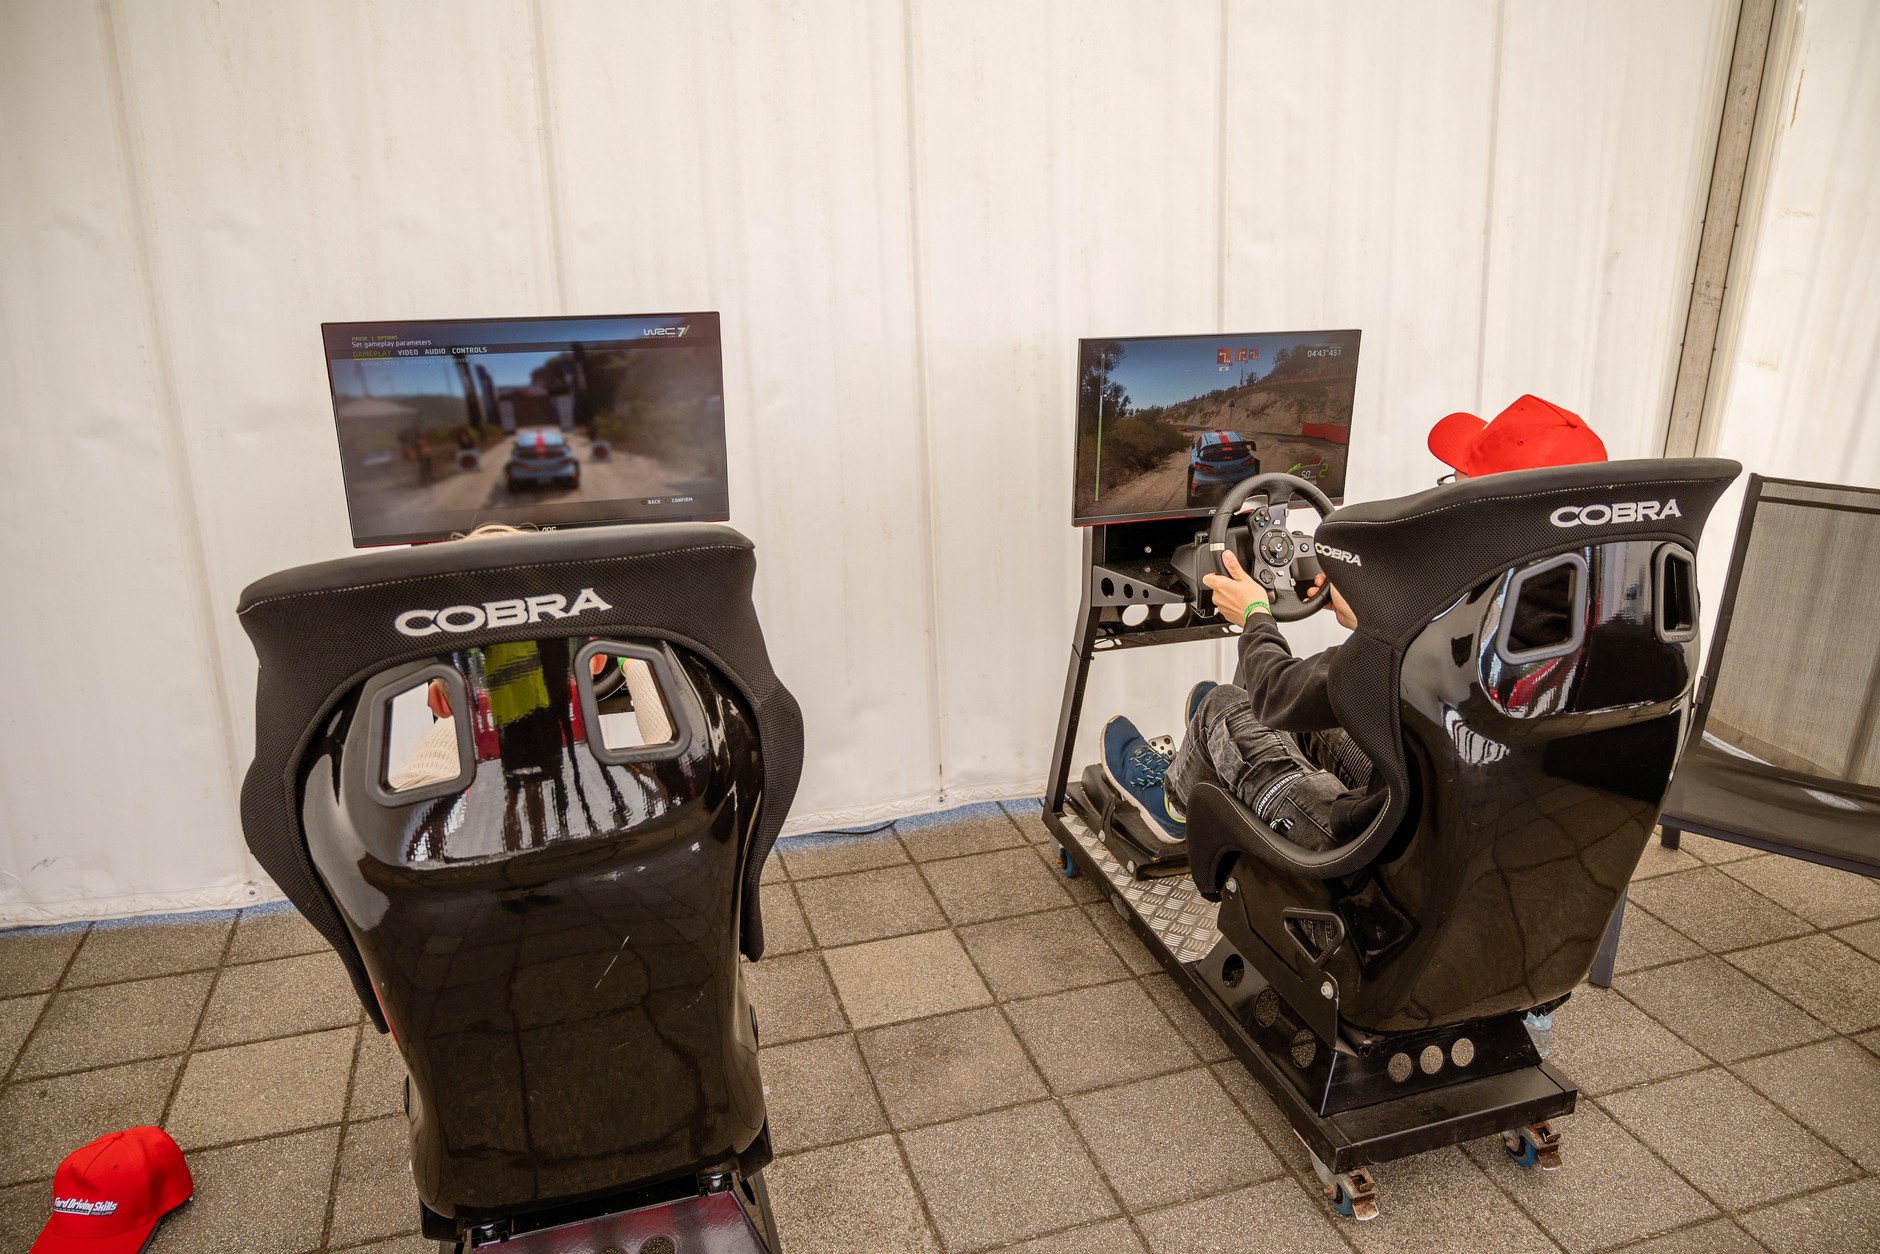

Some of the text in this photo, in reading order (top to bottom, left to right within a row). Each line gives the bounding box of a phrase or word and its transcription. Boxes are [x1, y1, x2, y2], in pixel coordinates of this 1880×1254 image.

[352, 350, 392, 358] GAMEPLAY
[451, 346, 488, 354] CONTROLS
[363, 341, 395, 349] gameplay
[395, 339, 432, 347] parameters
[1549, 498, 1682, 528] COBRA
[1314, 542, 1362, 567] COBRA
[394, 587, 613, 637] COBRA
[68, 1198, 94, 1213] Driving
[93, 1201, 118, 1211] Skills
